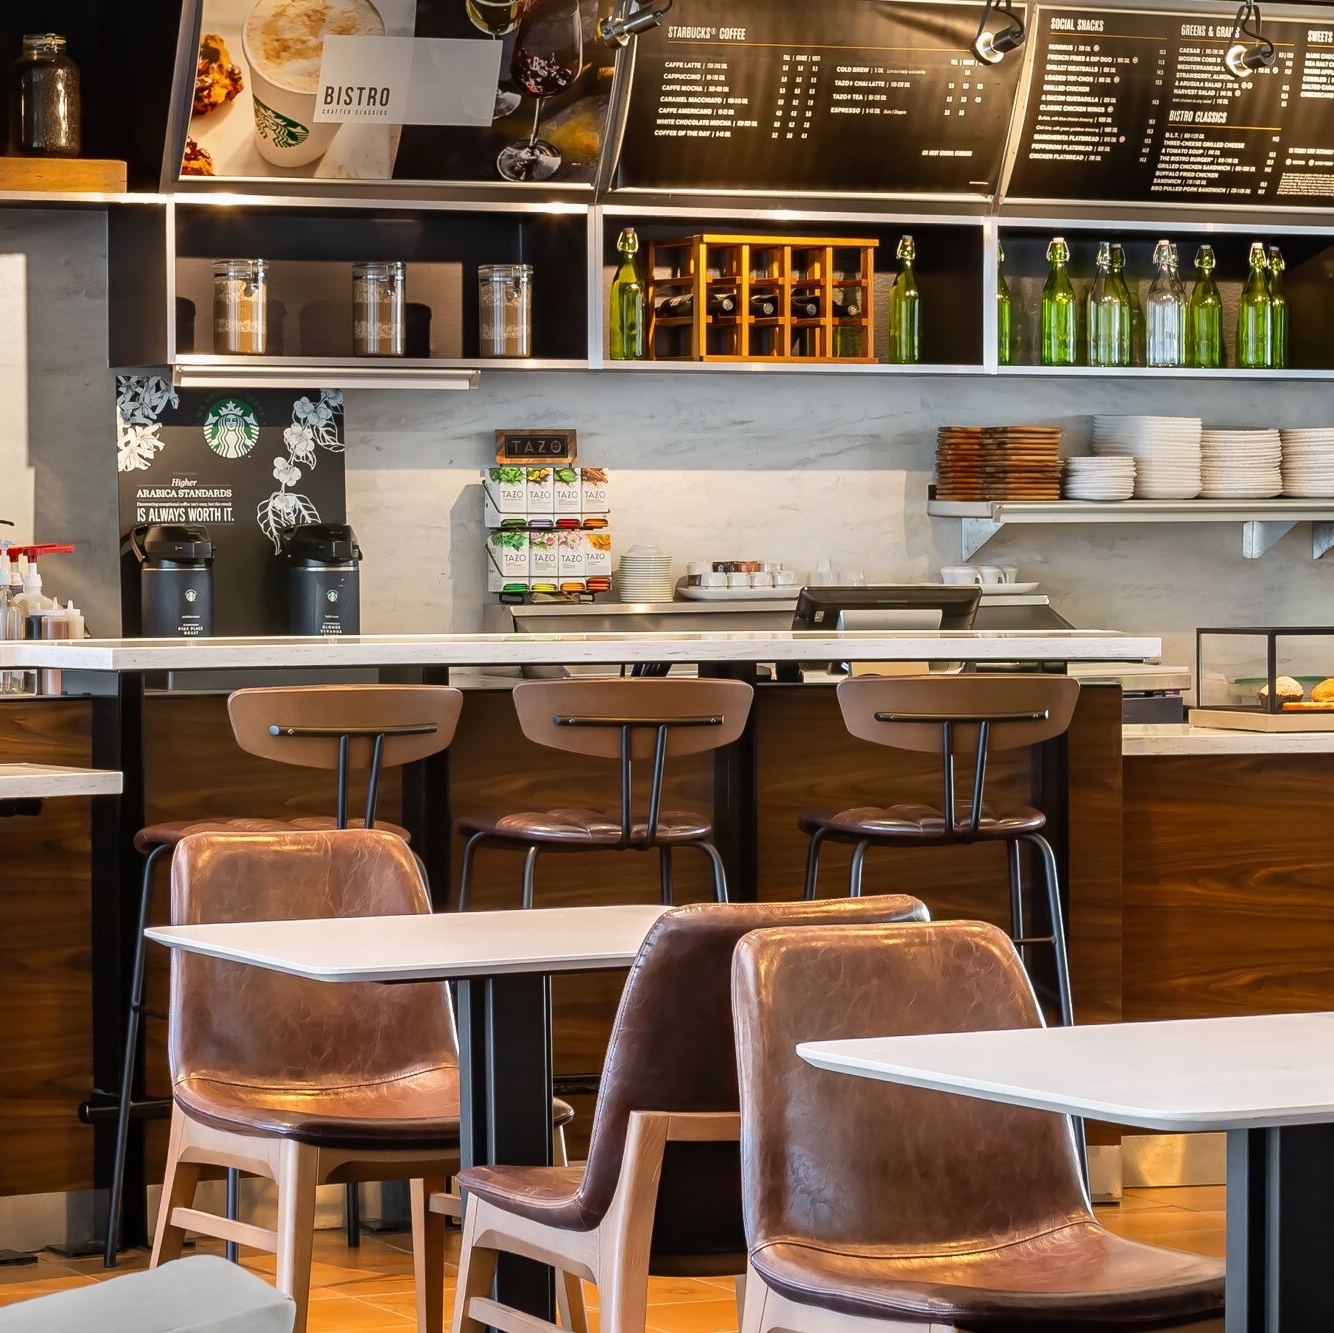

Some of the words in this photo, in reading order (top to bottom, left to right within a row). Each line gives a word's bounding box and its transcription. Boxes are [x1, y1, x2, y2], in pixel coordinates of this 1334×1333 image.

[1051, 18, 1075, 30] SOCIAL
[1077, 19, 1104, 31] SNACKS
[719, 28, 746, 40] COFFEE
[1181, 25, 1206, 36] GREENS
[1208, 26, 1214, 36] &
[1308, 31, 1333, 43] SWEETS
[324, 86, 390, 106] BISTRO
[1169, 111, 1193, 121] BISTRO
[1195, 111, 1227, 123] CLASSICS
[512, 440, 562, 453] TAZO
[171, 478, 197, 487] Higher
[137, 489, 177, 497] ARABICA
[178, 489, 232, 497] STANDARDS
[502, 490, 523, 499] TAZO
[529, 491, 551, 499] TAZO
[558, 491, 578, 499] TAZO
[585, 491, 606, 499] TAZO
[137, 508, 146, 522] IS
[149, 508, 185, 522] ALWAYS
[188, 508, 221, 522] WORTH
[224, 508, 234, 522] IT.
[505, 554, 526, 562] TAZO
[535, 554, 555, 562] TAZO
[561, 555, 582, 563] TAZO
